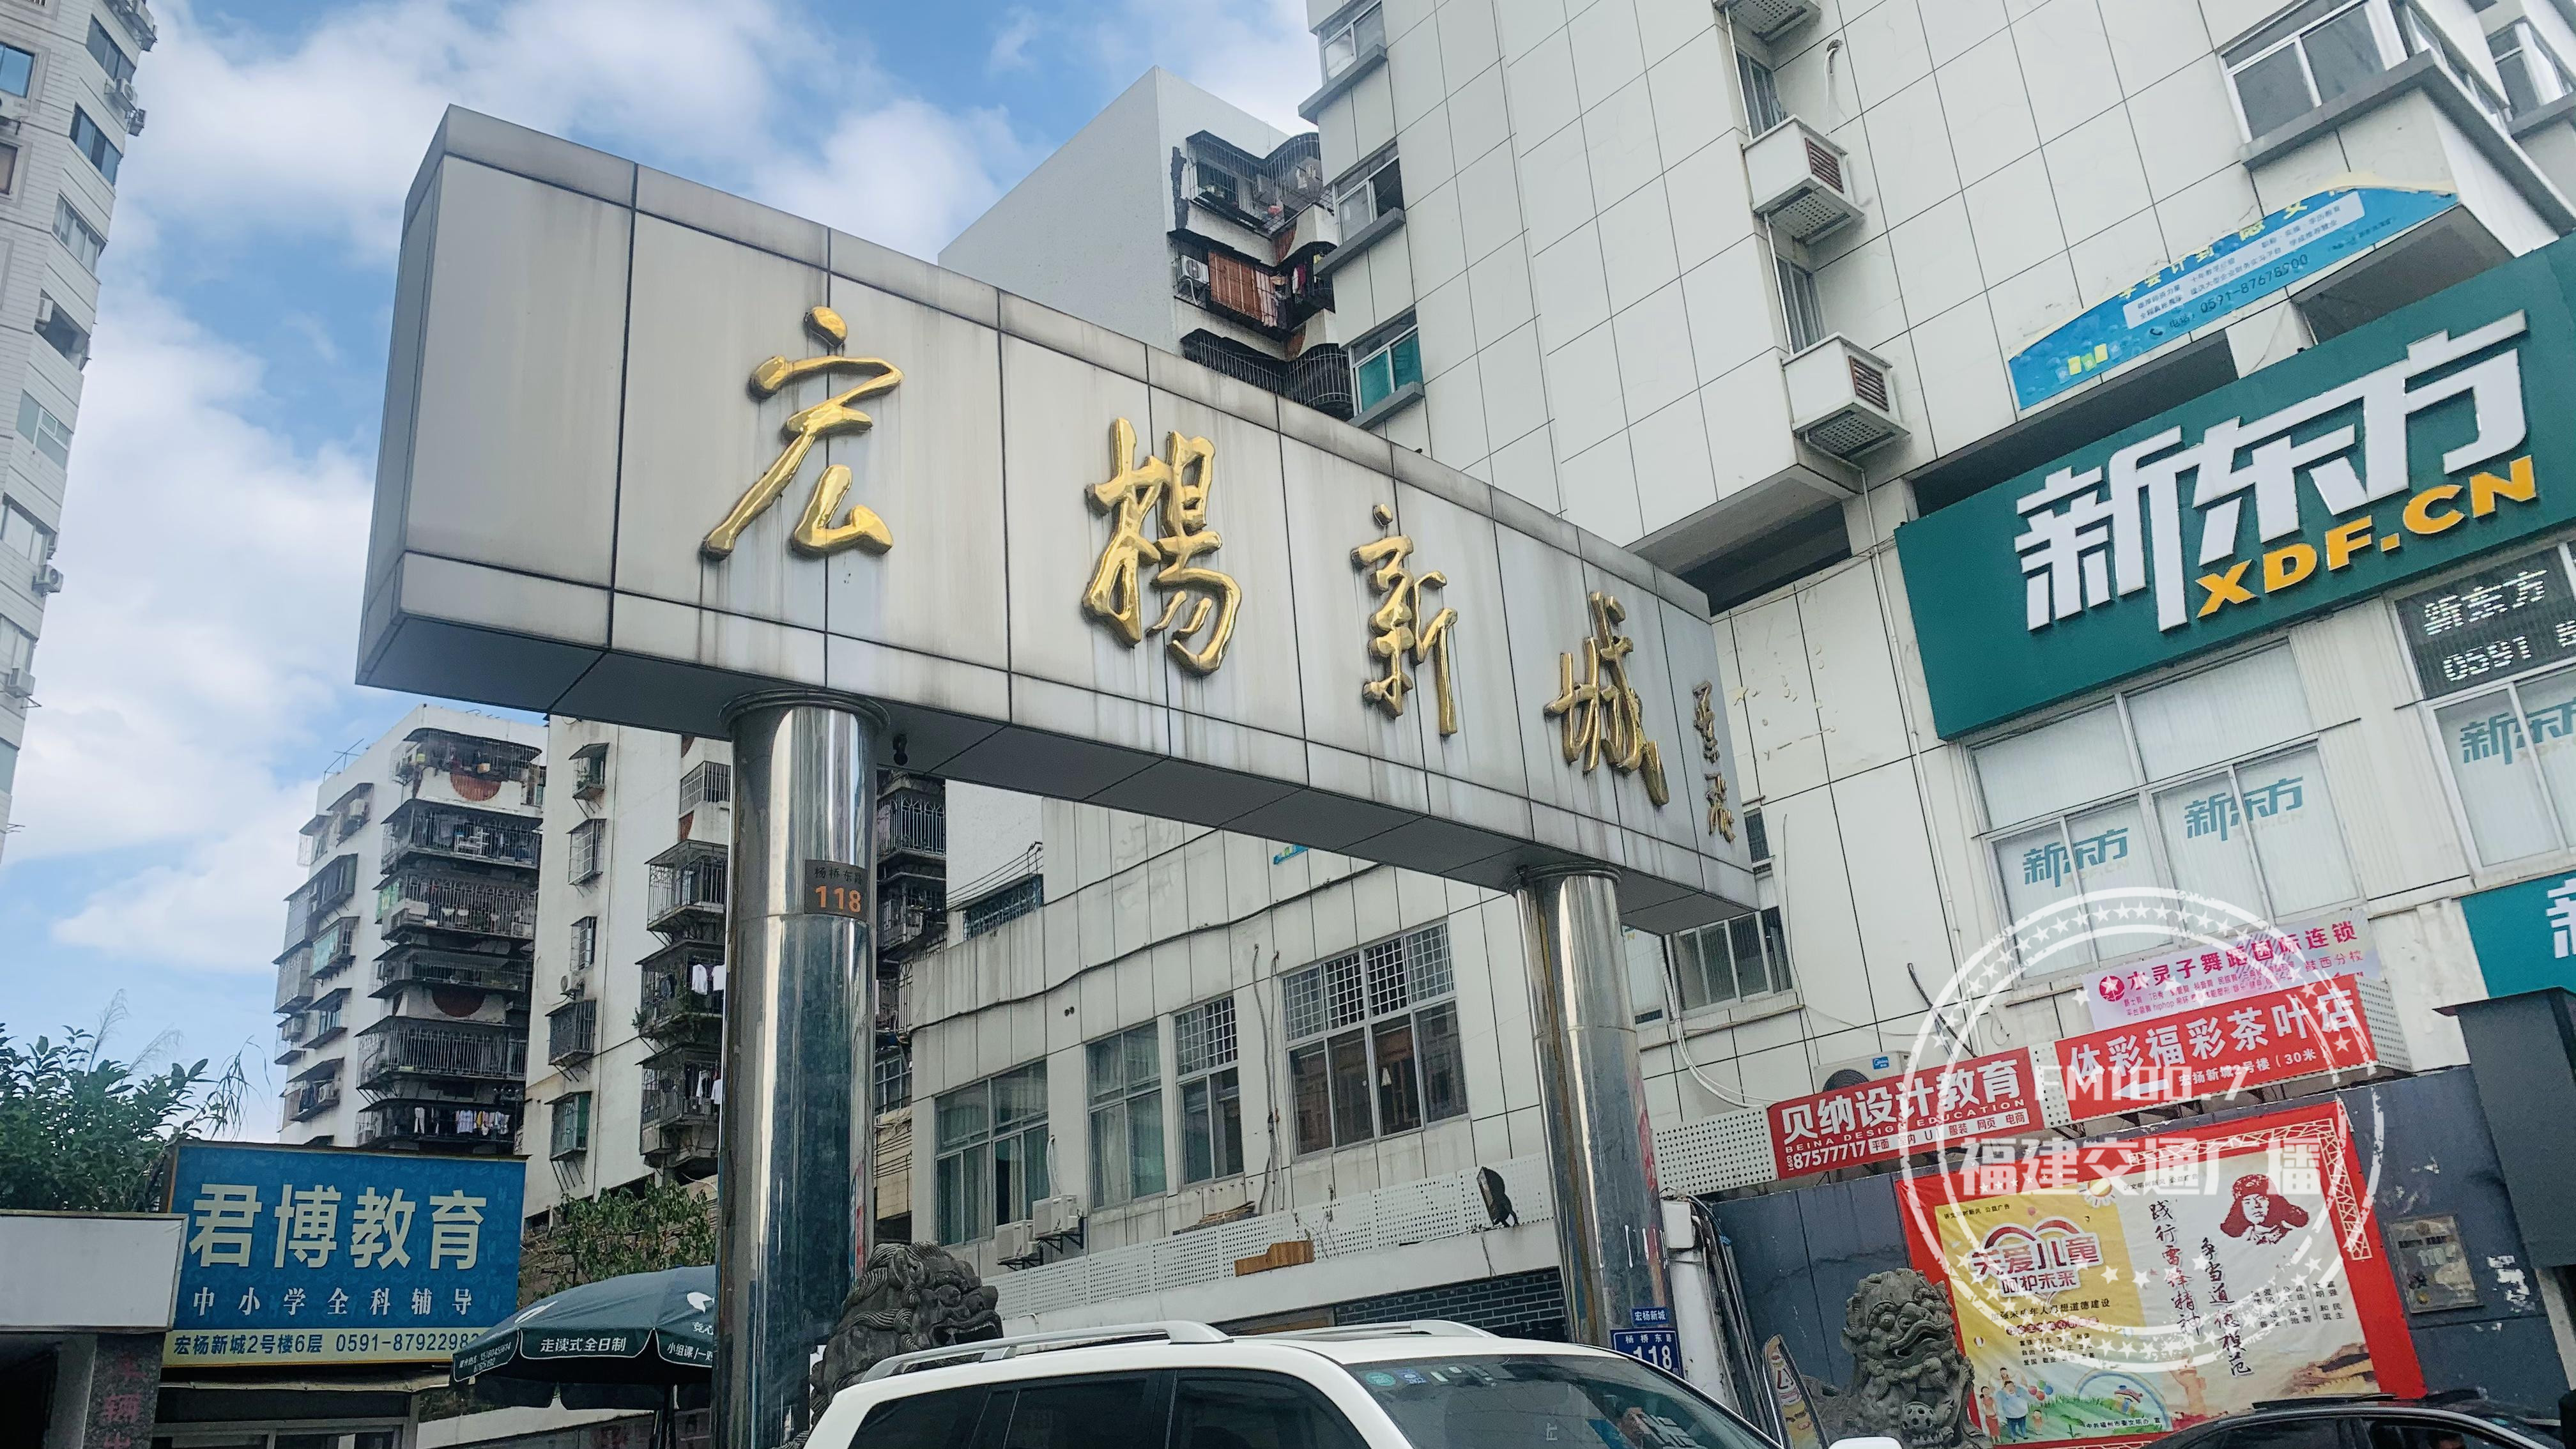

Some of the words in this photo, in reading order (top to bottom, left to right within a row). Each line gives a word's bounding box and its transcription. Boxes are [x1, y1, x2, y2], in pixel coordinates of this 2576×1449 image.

[2014, 309, 2529, 632] 新东方
[2196, 454, 2538, 618] XDF.CN
[2424, 570, 2547, 635] 新东方
[2442, 635, 2532, 681] 0591
[2183, 776, 2304, 841] 新东方
[2022, 827, 2129, 888] 新东方
[815, 884, 861, 913] 118
[2069, 987, 2358, 1081] 体彩福彩茶叶店
[1781, 1058, 2020, 1146] 贝纳设计教育
[1786, 1138, 1834, 1153] BEINA
[1843, 1123, 1907, 1142] DESIGN
[1917, 1099, 2025, 1127] EDUCATION
[1872, 1138, 1890, 1151] 平面
[1949, 1123, 1968, 1136] 服装
[1977, 1117, 1997, 1130] 网页
[2005, 1112, 2025, 1125] 电商
[1793, 1140, 1866, 1170] 87577717
[190, 1183, 487, 1270] 君博教育
[1985, 1203, 2010, 1213] 公益广告
[1972, 1236, 2100, 1276] 关爱儿童
[193, 1286, 473, 1317] 中小学全科辅导
[2002, 1269, 2076, 1294] 呵护未来
[540, 1337, 627, 1353] 走读式全日制
[1633, 1344, 1673, 1370] 118
